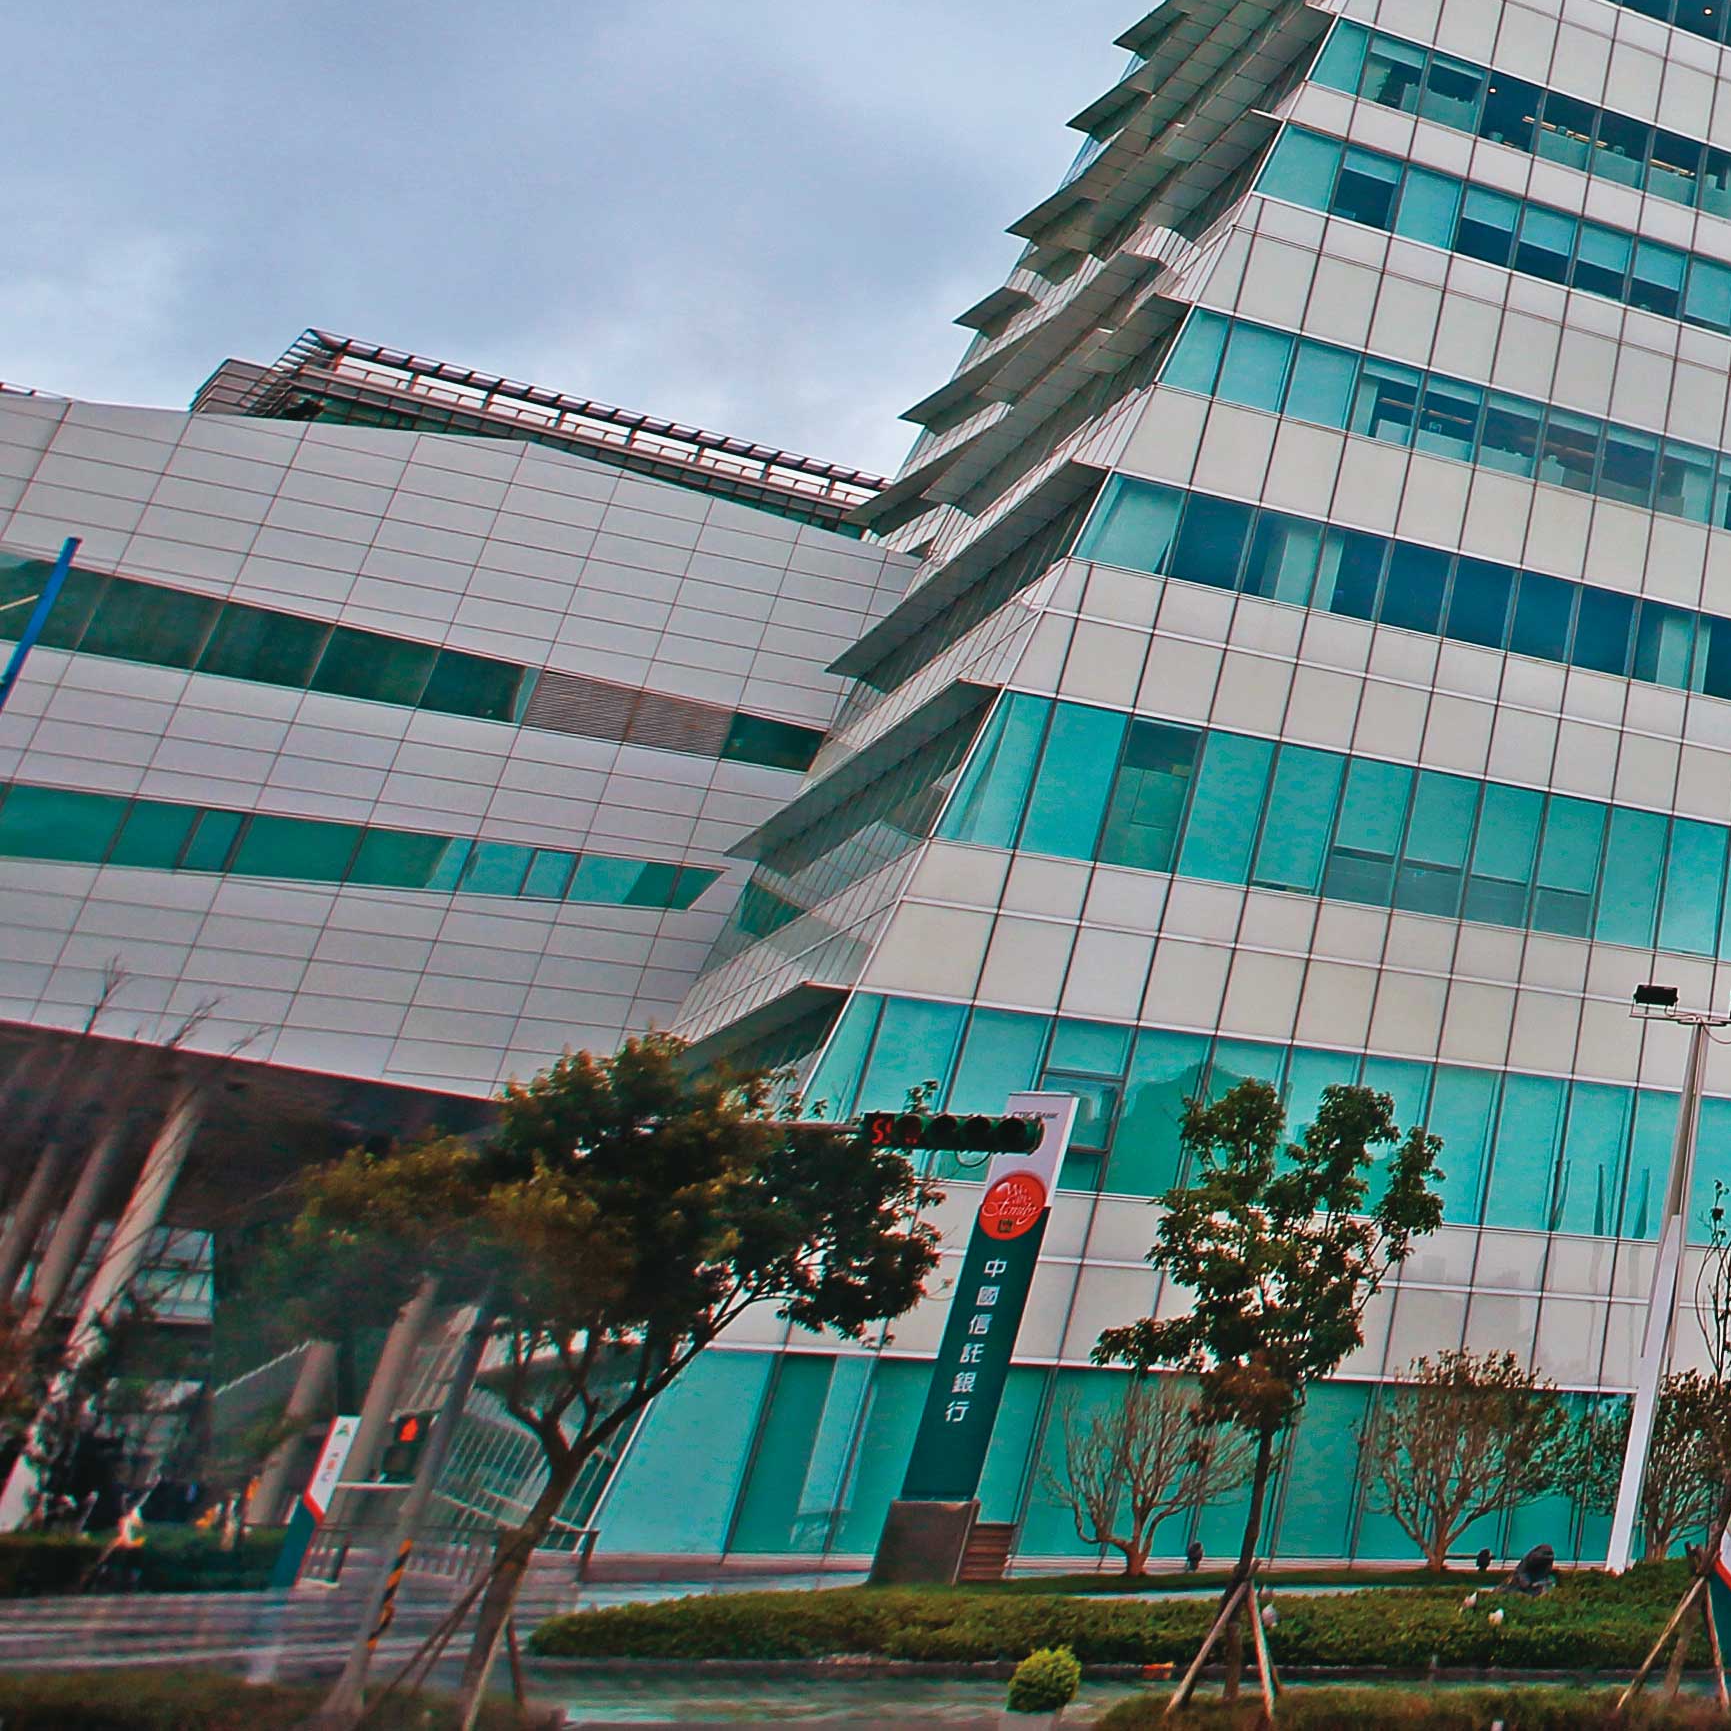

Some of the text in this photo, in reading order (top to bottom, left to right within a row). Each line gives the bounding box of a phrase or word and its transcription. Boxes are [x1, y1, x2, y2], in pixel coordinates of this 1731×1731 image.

[944, 1258, 1008, 1422] 中國信託銀行
